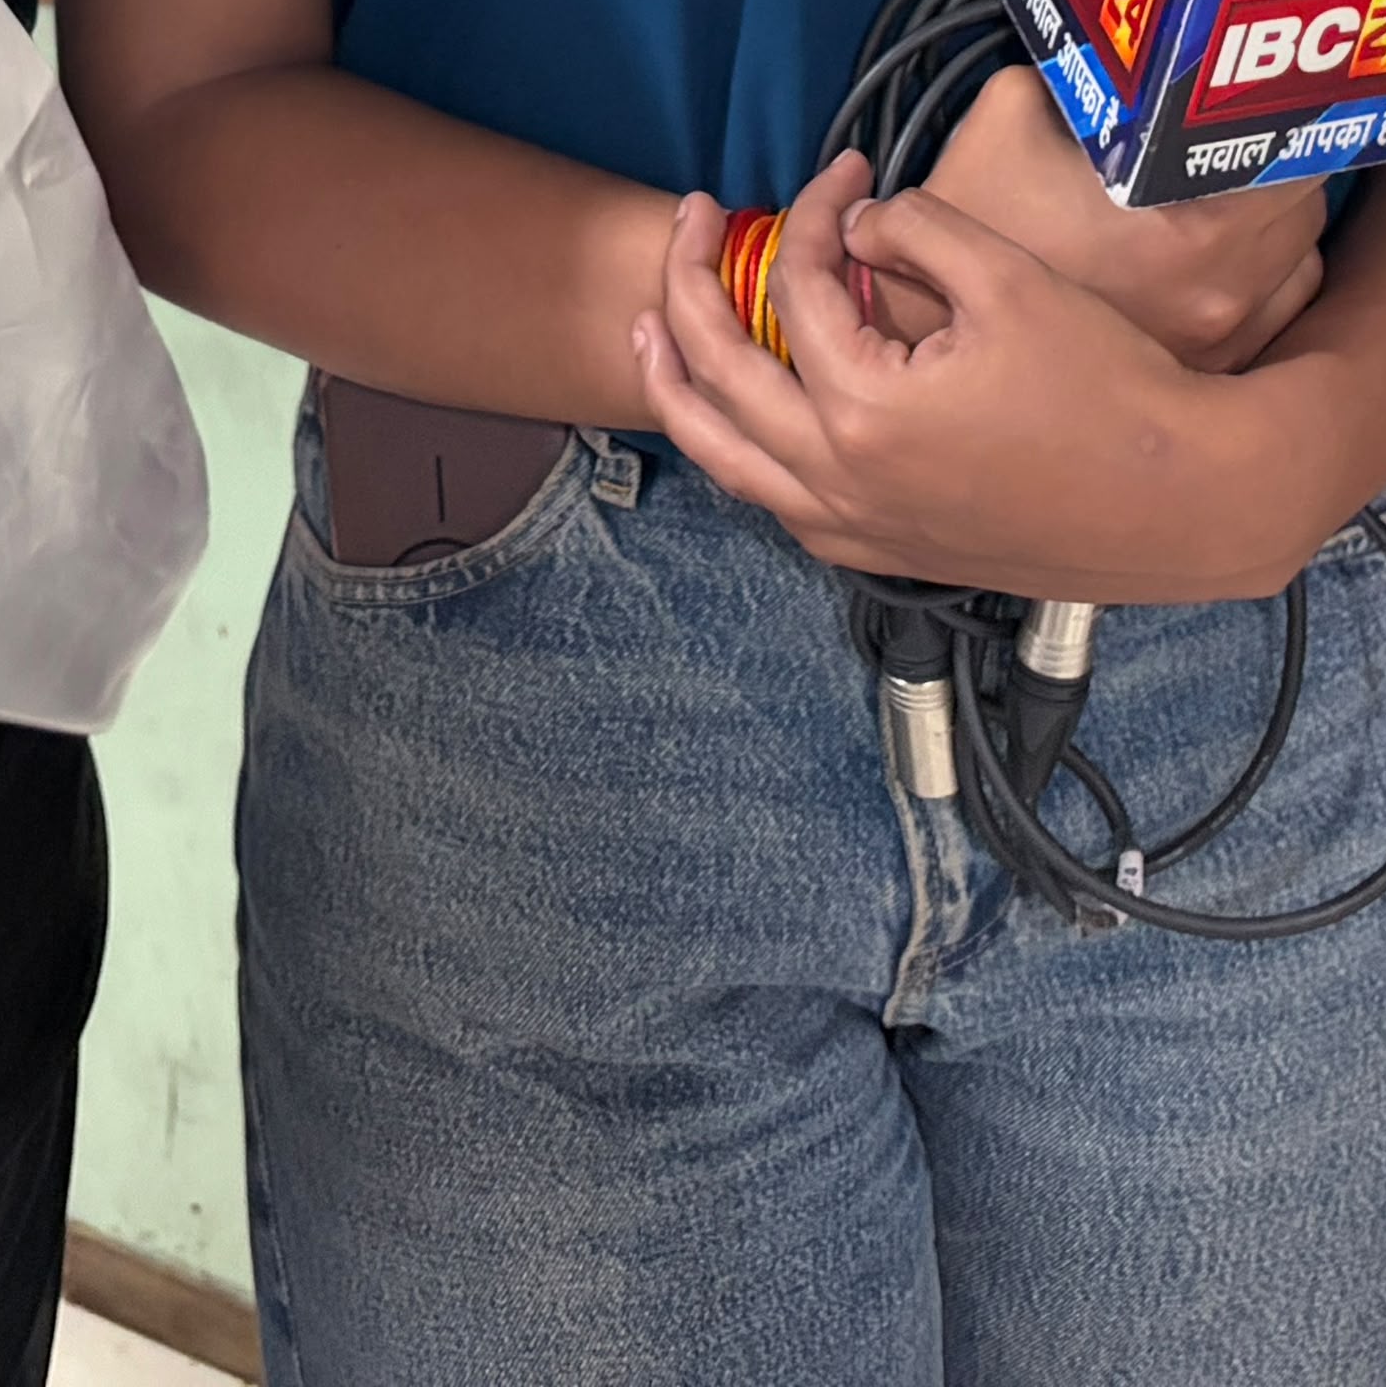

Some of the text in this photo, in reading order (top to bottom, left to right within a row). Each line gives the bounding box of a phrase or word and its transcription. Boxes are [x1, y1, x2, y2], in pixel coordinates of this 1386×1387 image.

[1058, 32, 1106, 128] आपका
[1098, 95, 1120, 150] है
[1185, 131, 1277, 178] सवाल
[1278, 112, 1378, 161] आपका
